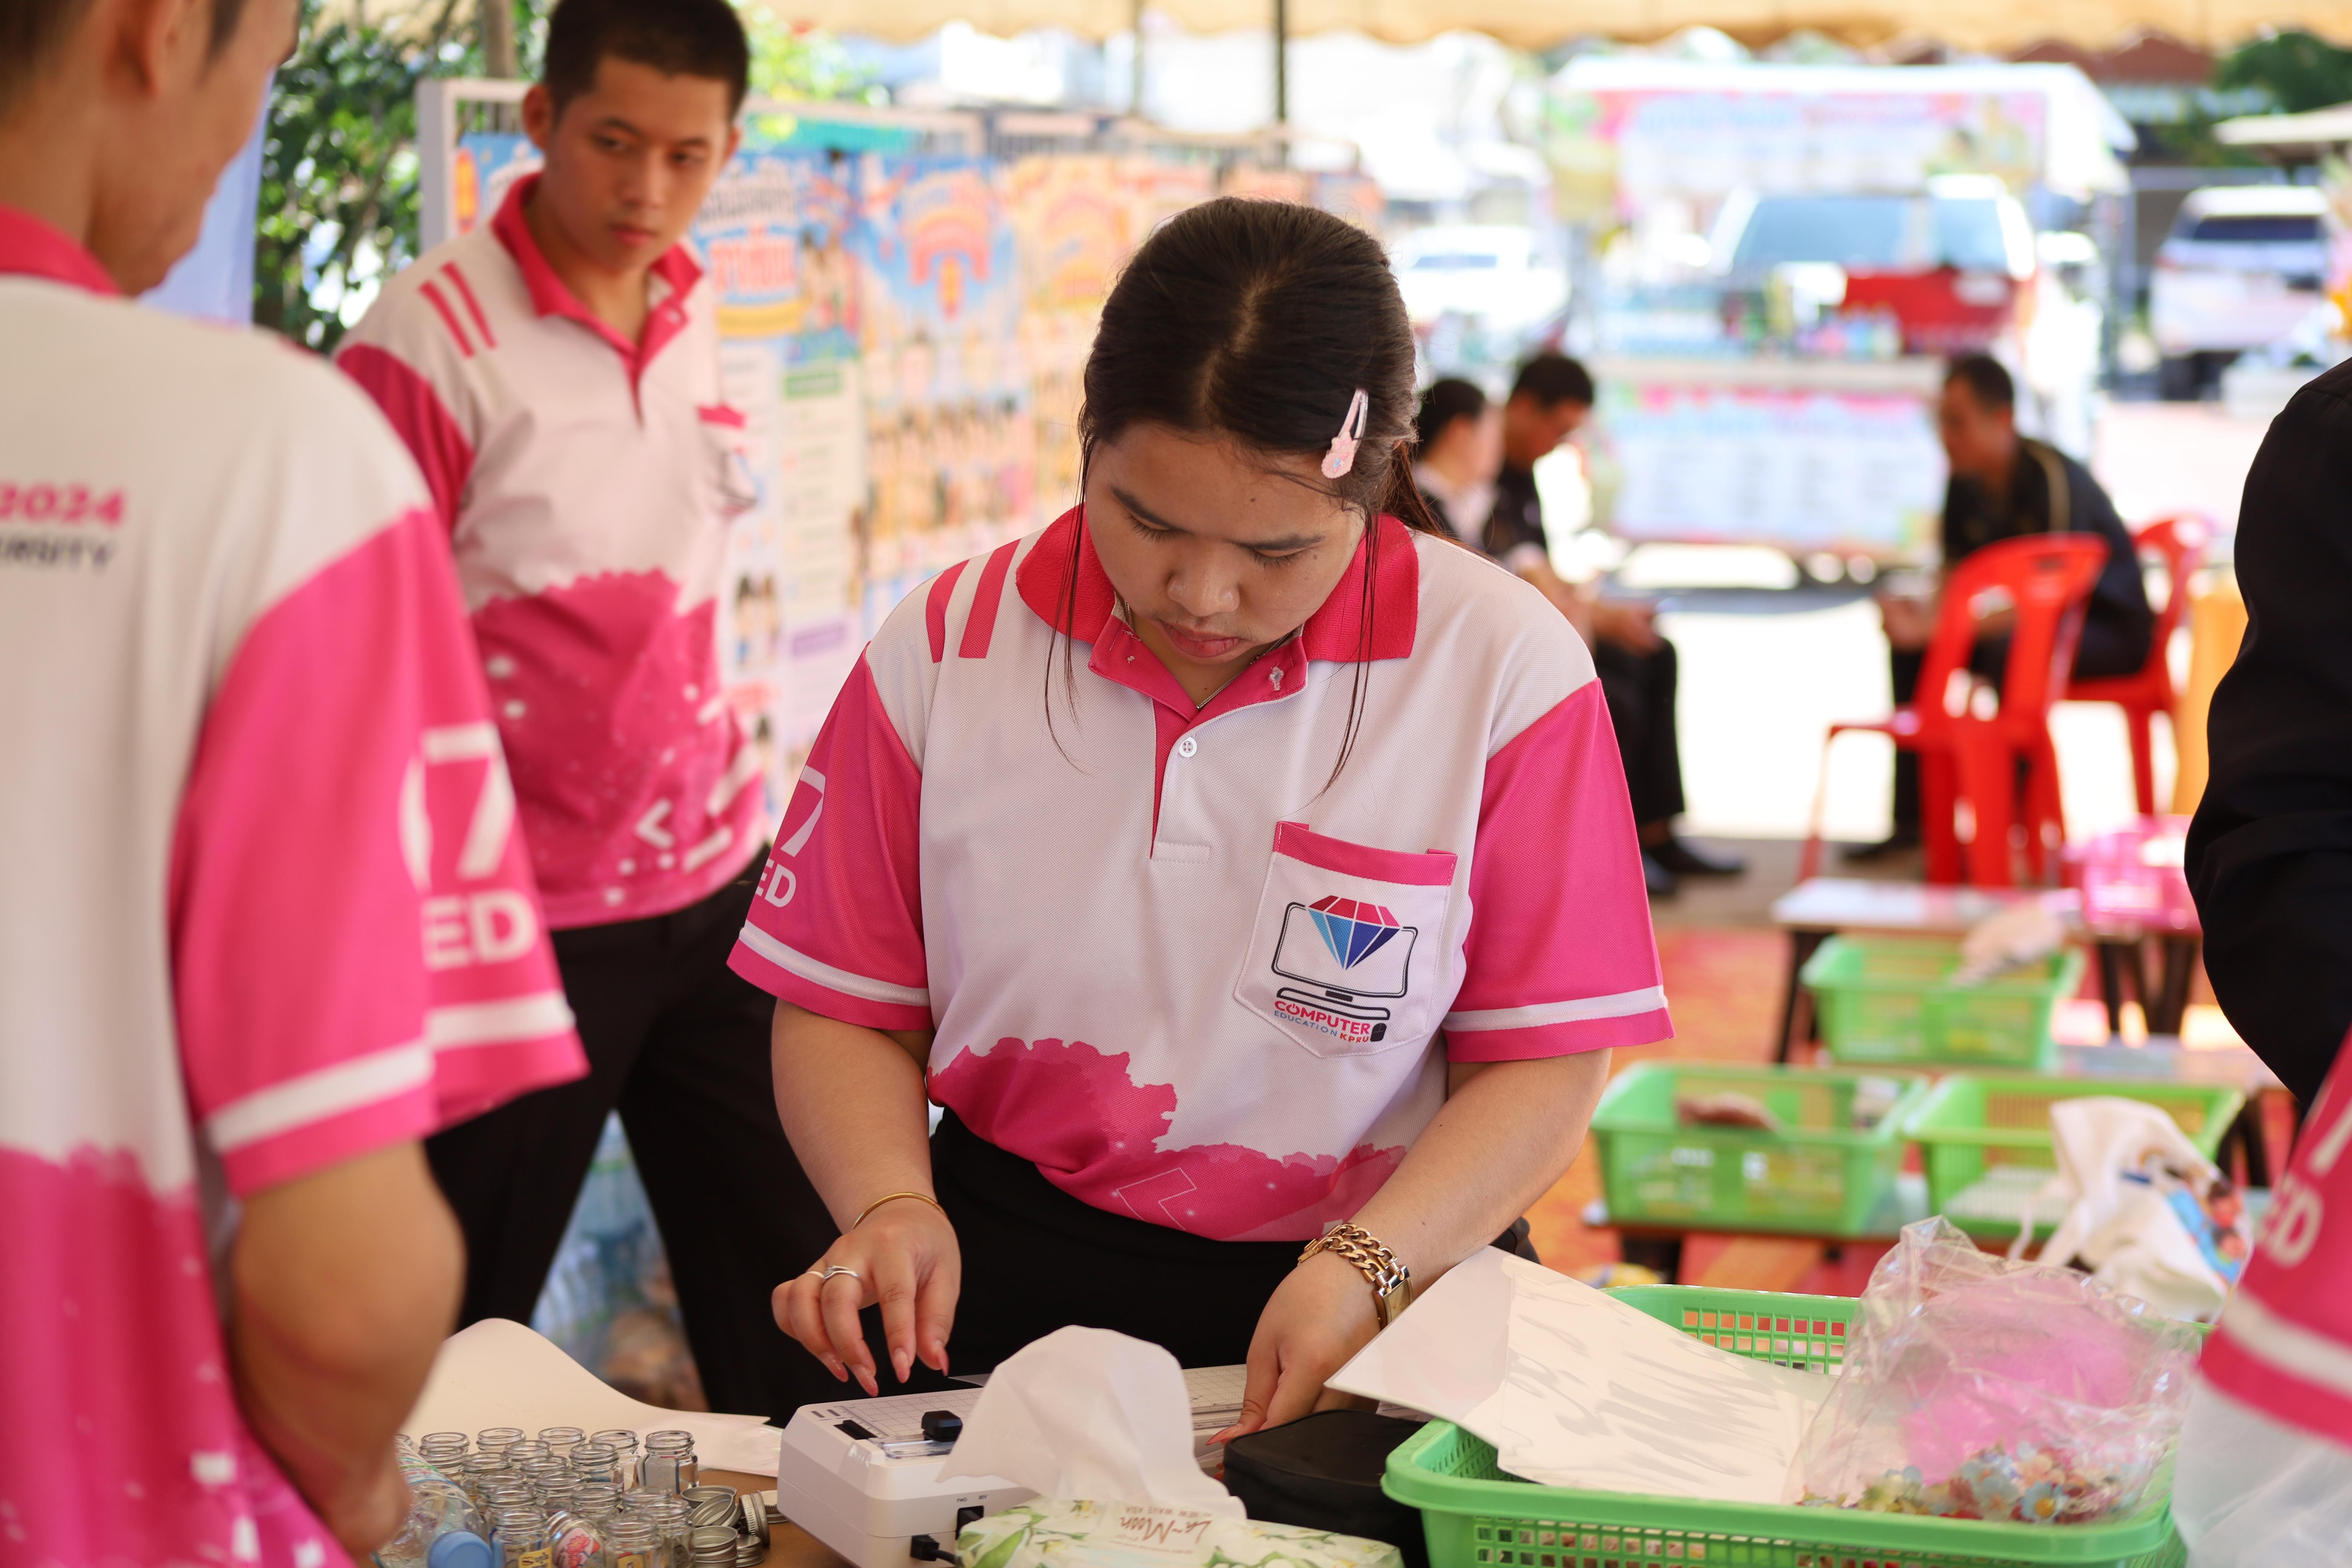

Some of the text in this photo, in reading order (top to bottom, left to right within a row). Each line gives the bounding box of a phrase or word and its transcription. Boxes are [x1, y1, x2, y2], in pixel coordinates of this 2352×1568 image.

[1274, 1001, 1371, 1035] COMPUTER
[1274, 1011, 1369, 1043] EDUCATION KPRU
